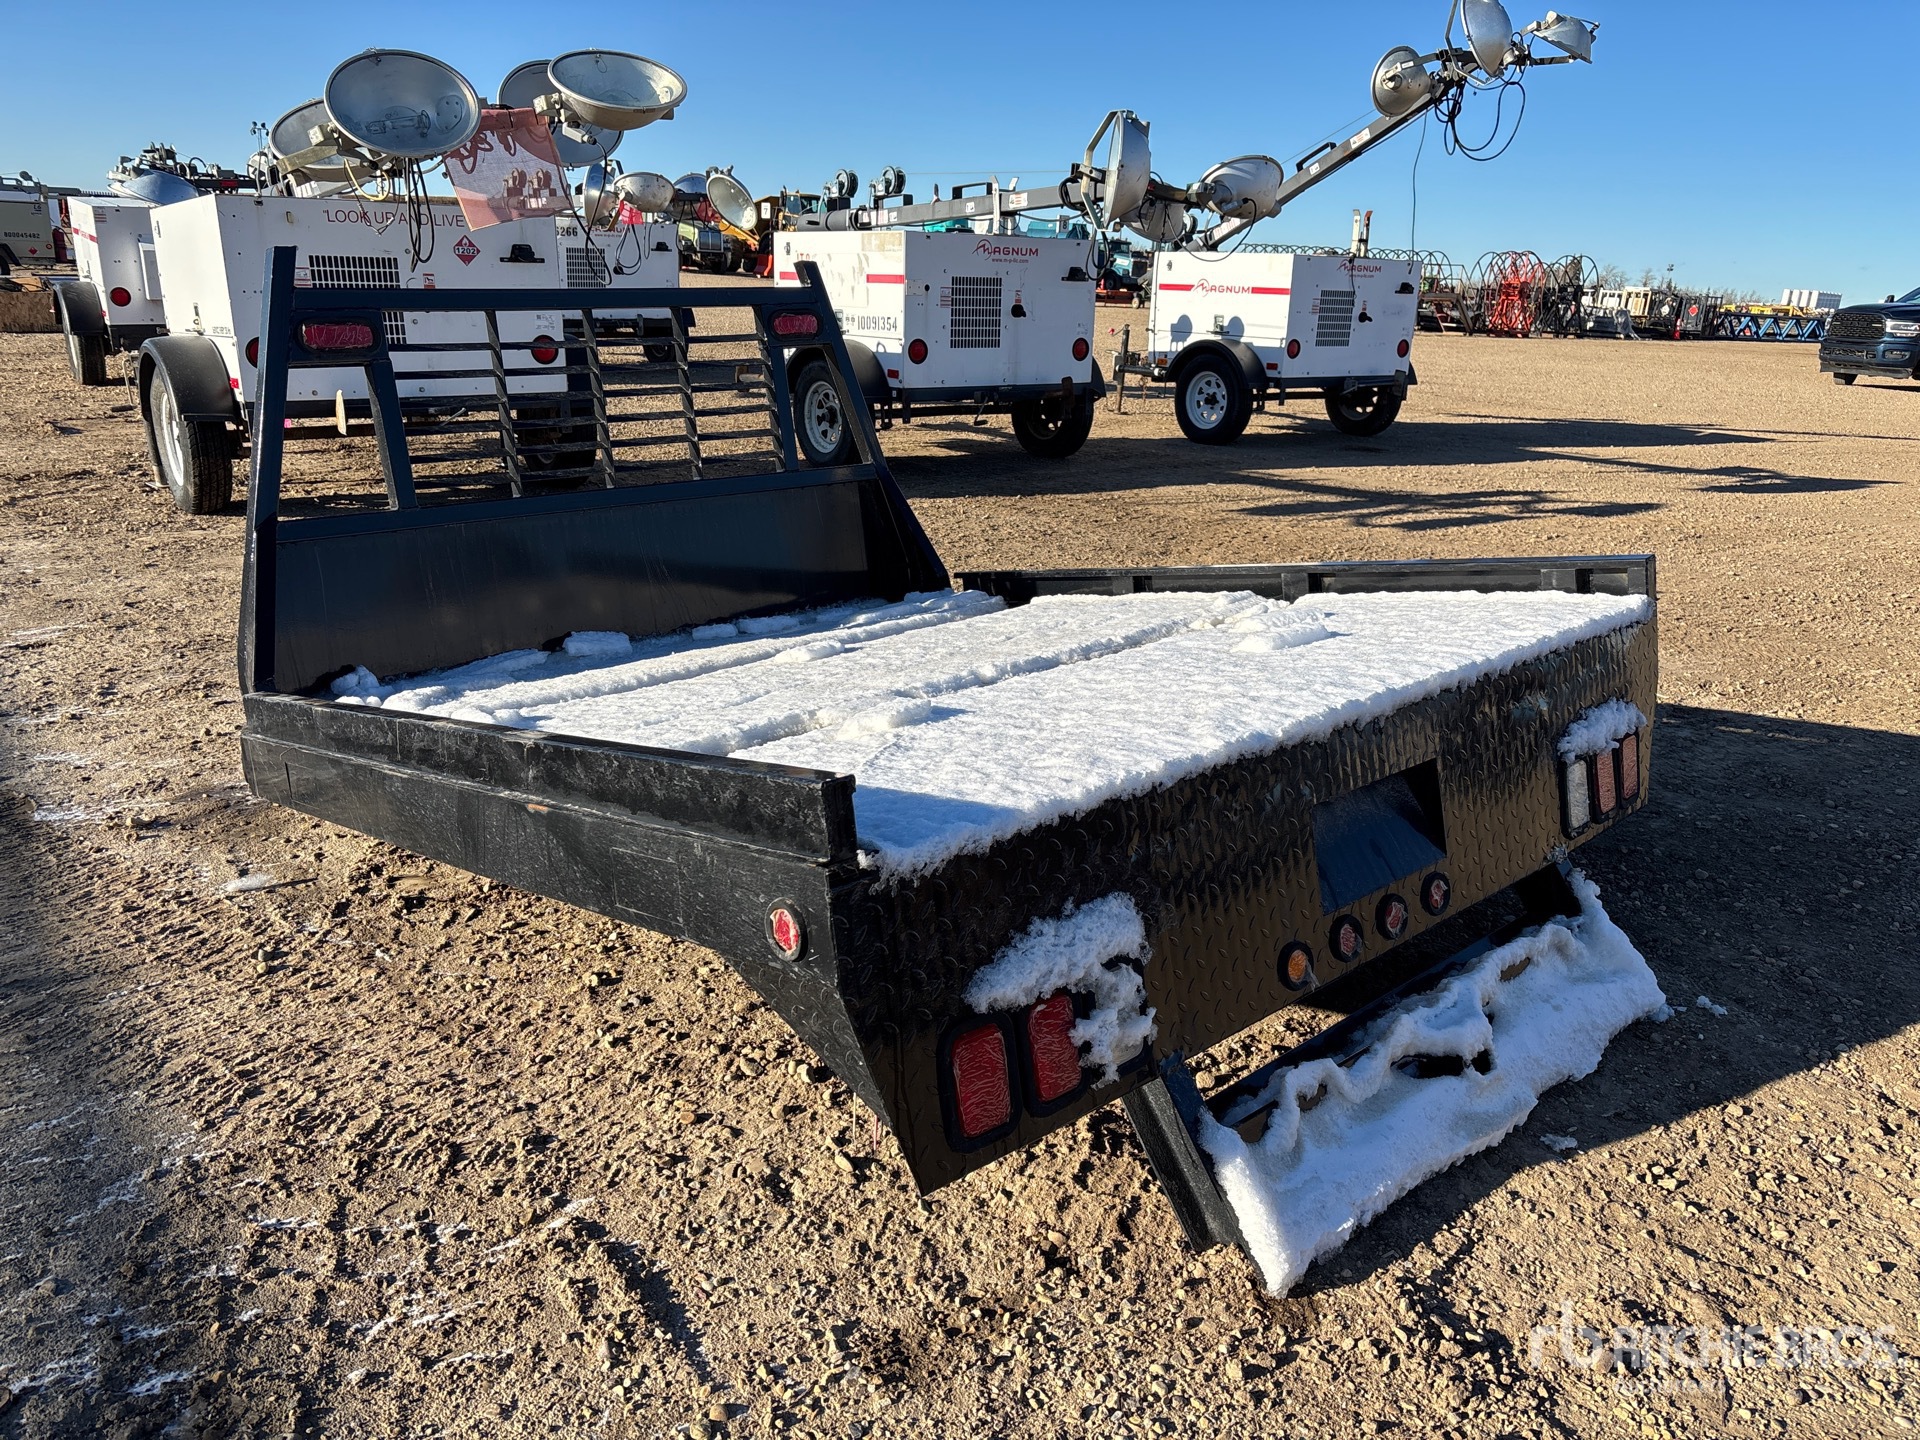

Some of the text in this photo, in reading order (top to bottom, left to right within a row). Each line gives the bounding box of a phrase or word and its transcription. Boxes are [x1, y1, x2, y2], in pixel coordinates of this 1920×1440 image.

[374, 211, 395, 225] UP
[433, 213, 466, 228] LIVE
[456, 247, 476, 255] 1202
[972, 240, 1039, 259] MAGNUM
[1337, 260, 1382, 274] MAGNUM
[1193, 279, 1250, 295] MAGNUM
[857, 315, 897, 332] 10091354
